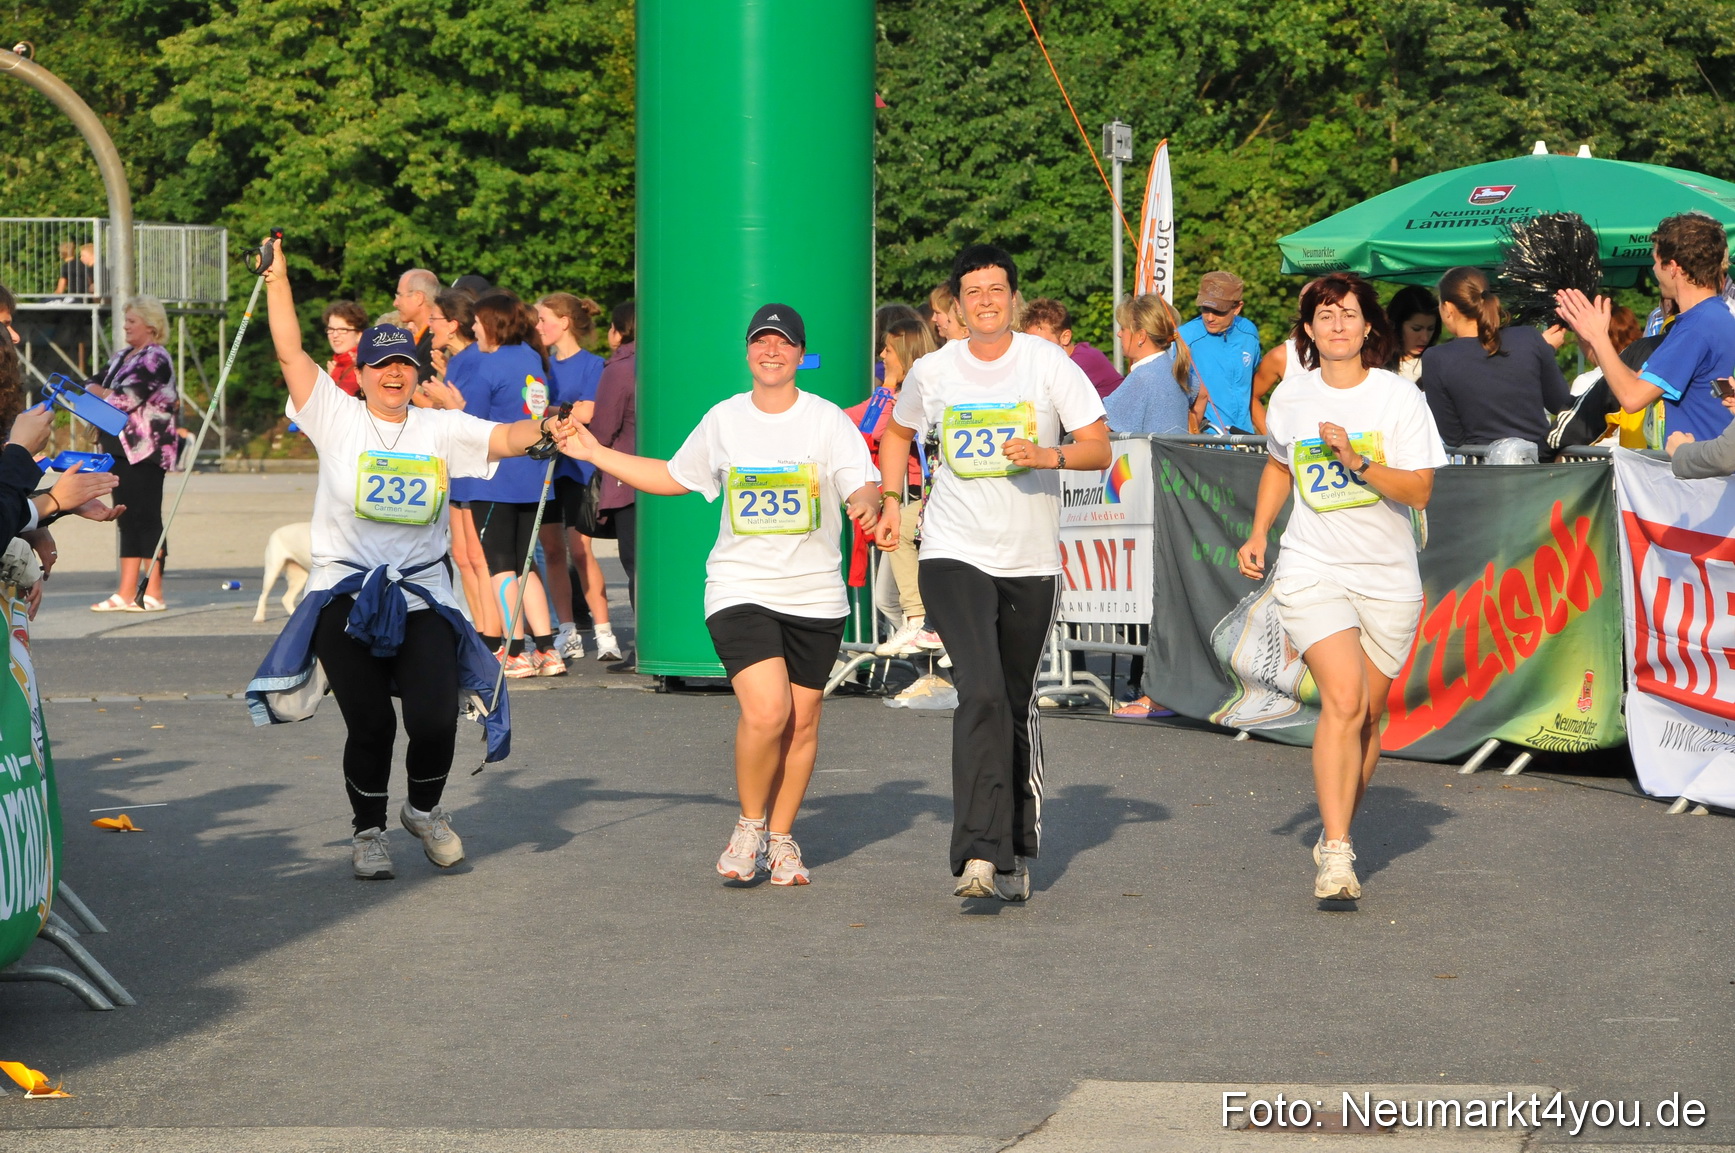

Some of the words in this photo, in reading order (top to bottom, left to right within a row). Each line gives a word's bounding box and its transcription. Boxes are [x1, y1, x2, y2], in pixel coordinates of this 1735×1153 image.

[1430, 207, 1532, 218] Neumarkter
[1302, 247, 1335, 258] Neumarkter
[953, 427, 1016, 459] 237
[365, 475, 428, 507] 232
[1060, 481, 1103, 508] hmann
[1321, 490, 1346, 500] Evelyn
[374, 504, 403, 513] Carmen
[738, 489, 801, 517] 235
[1090, 511, 1125, 521] Medien
[1553, 713, 1598, 736] Neumarkter
